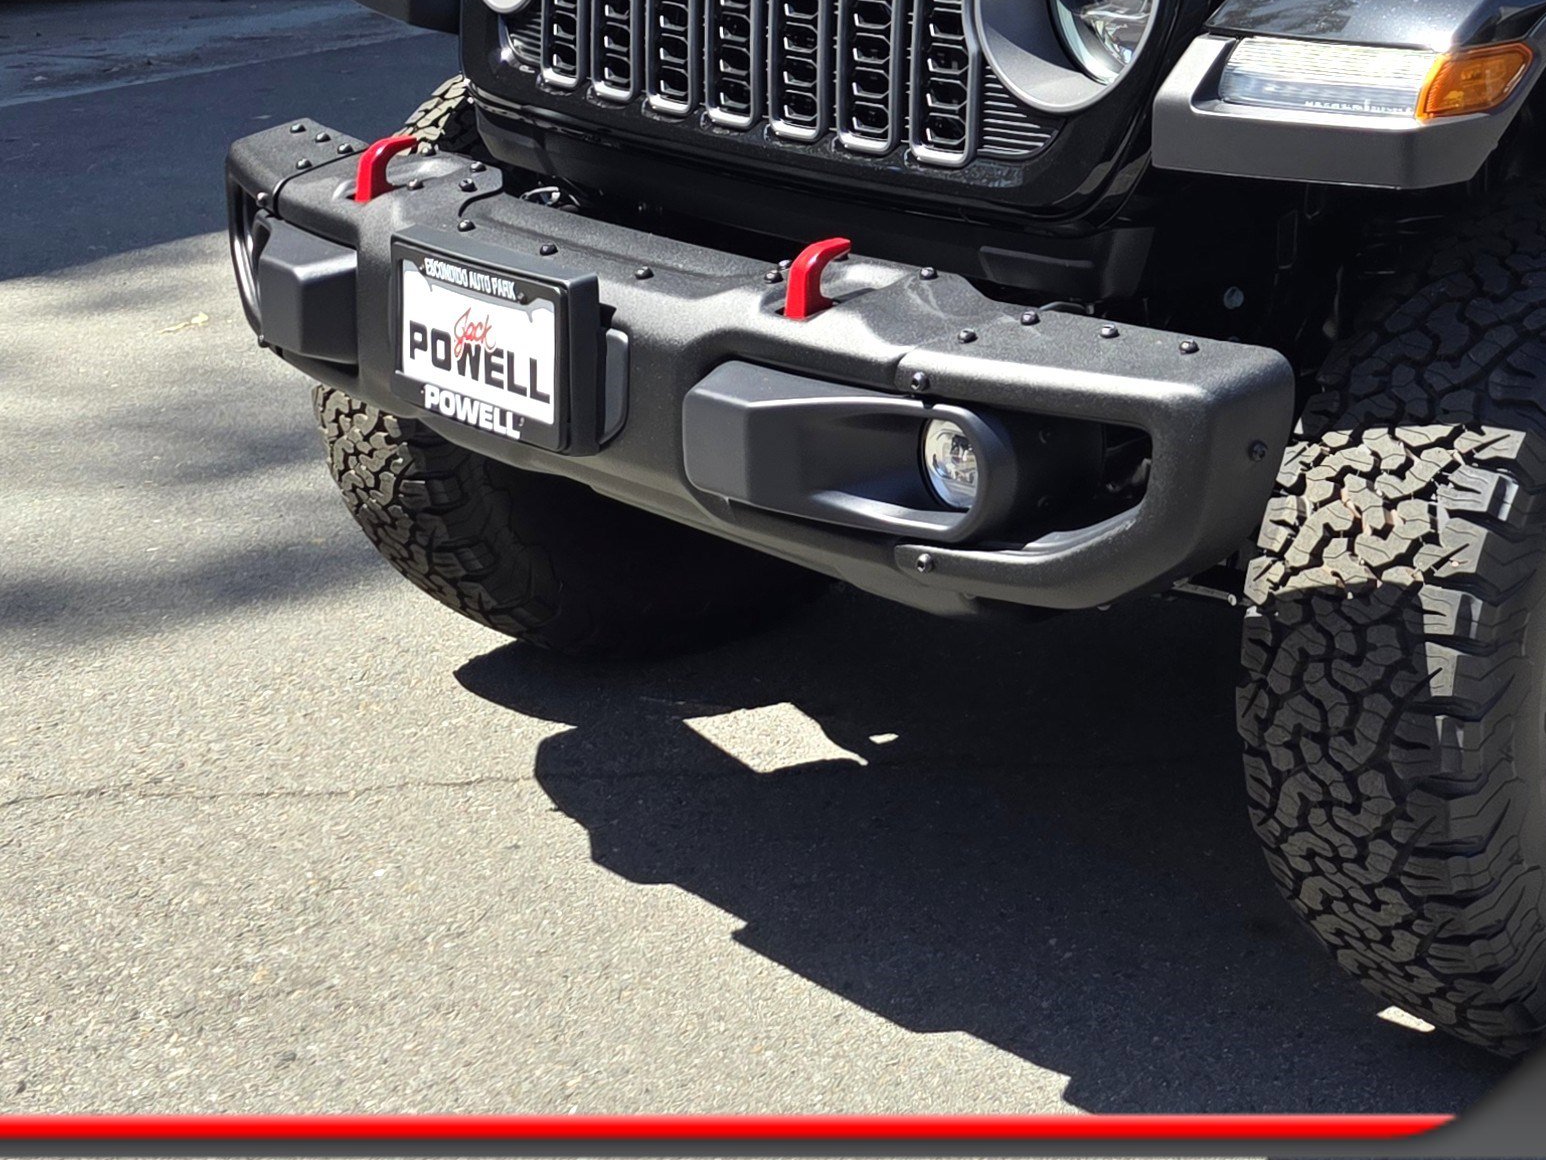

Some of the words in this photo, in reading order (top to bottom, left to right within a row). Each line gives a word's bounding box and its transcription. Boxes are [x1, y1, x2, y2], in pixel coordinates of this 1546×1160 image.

[424, 258, 469, 288] ESCONDIDO
[469, 271, 491, 294] AUTO
[492, 279, 516, 301] PARK
[453, 307, 496, 358] Jack
[409, 320, 550, 404] POWELL
[424, 384, 520, 440] POWELL
